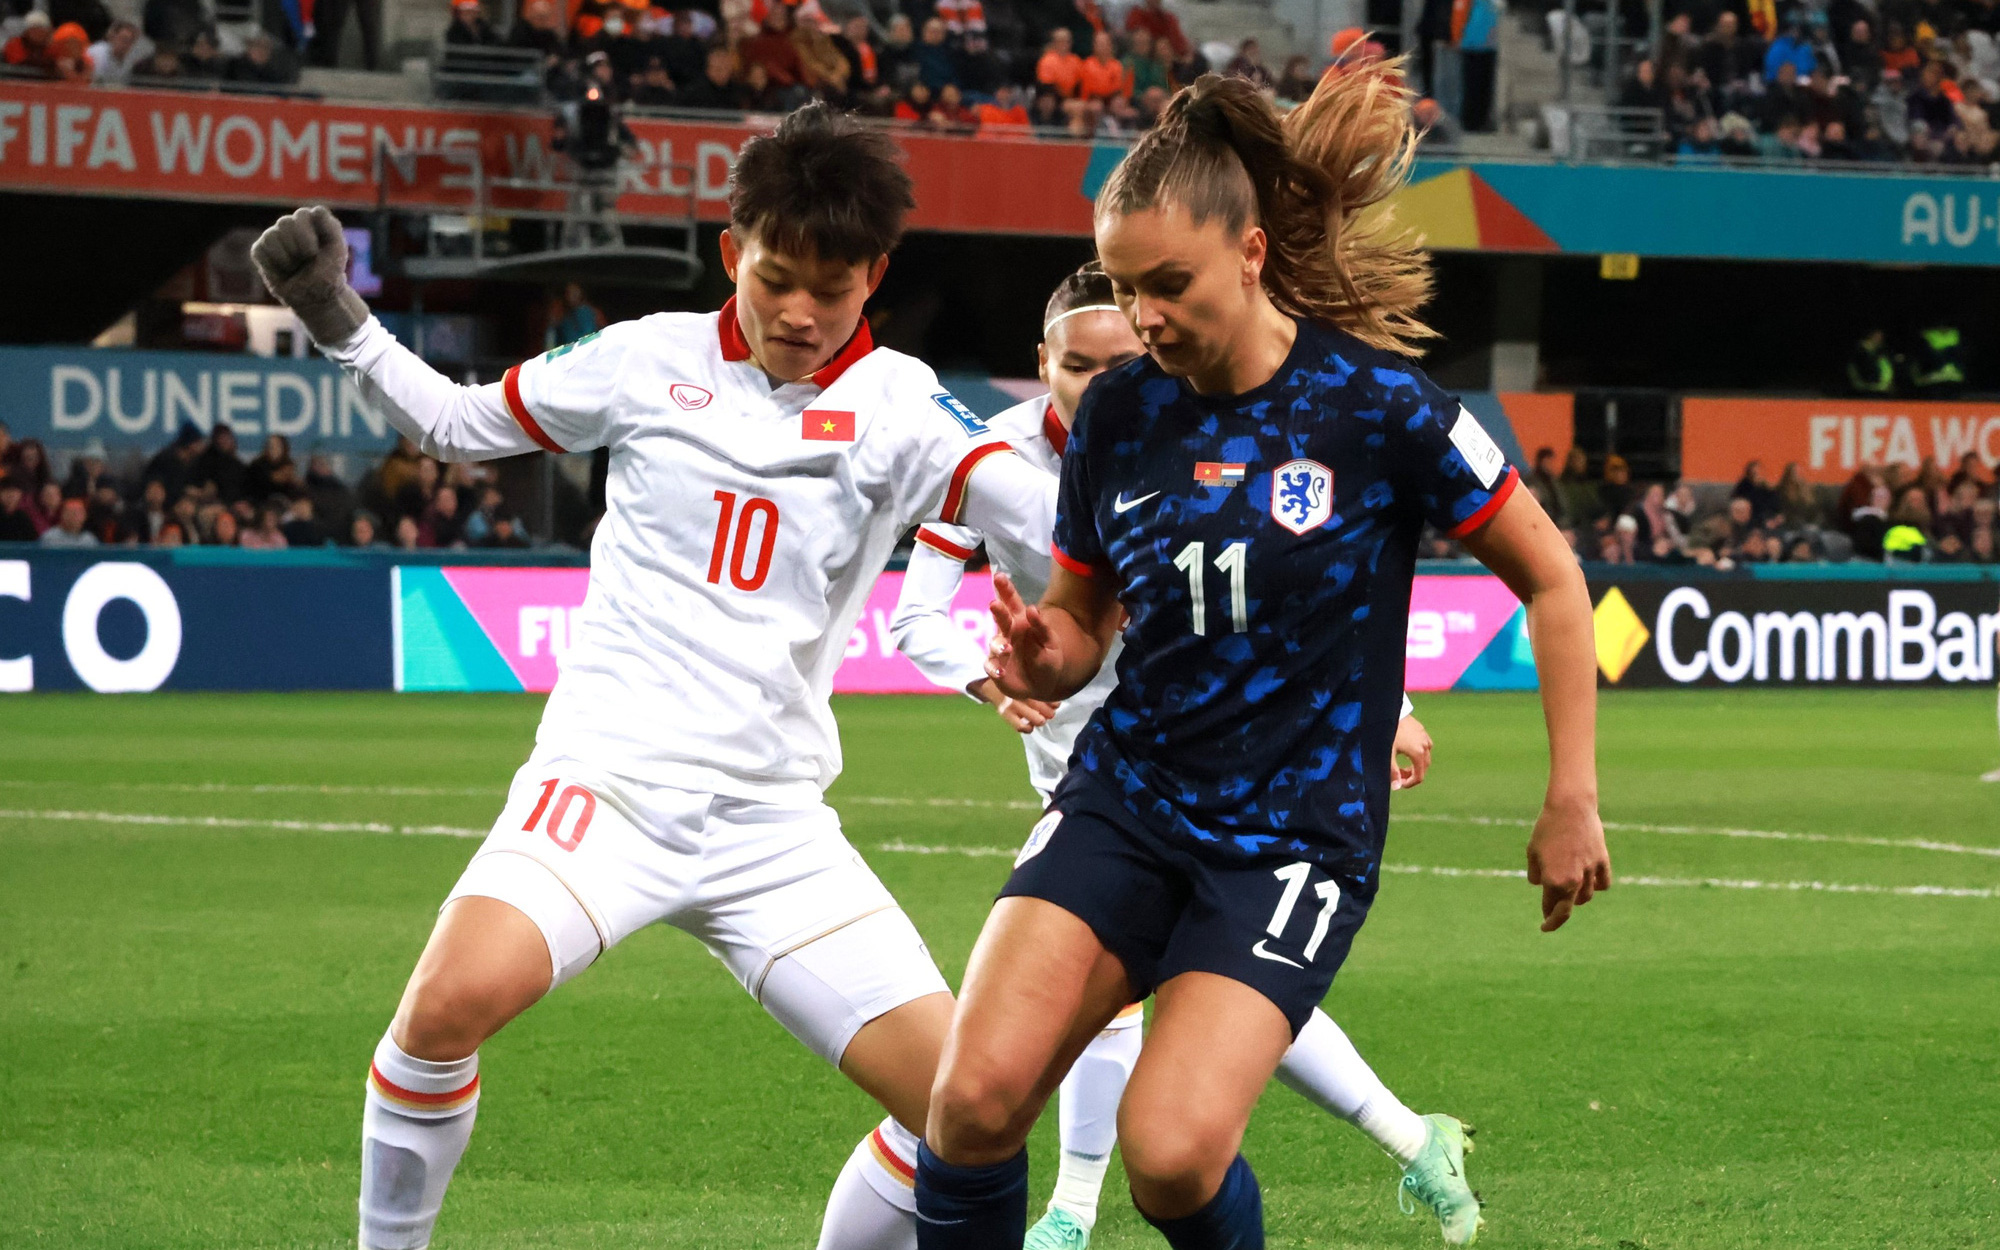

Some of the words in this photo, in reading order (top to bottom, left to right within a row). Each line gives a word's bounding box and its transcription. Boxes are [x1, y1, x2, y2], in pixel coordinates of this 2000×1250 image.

[0, 101, 136, 172] FIFA
[151, 110, 482, 188] WOMEN'S
[503, 133, 738, 201] WRLD
[51, 365, 387, 438] DUNEDIN
[1810, 415, 1921, 470] FIFA
[706, 490, 780, 592] 10
[1173, 541, 1248, 636] 11
[521, 778, 597, 853] 10
[1272, 861, 1341, 963] 11
